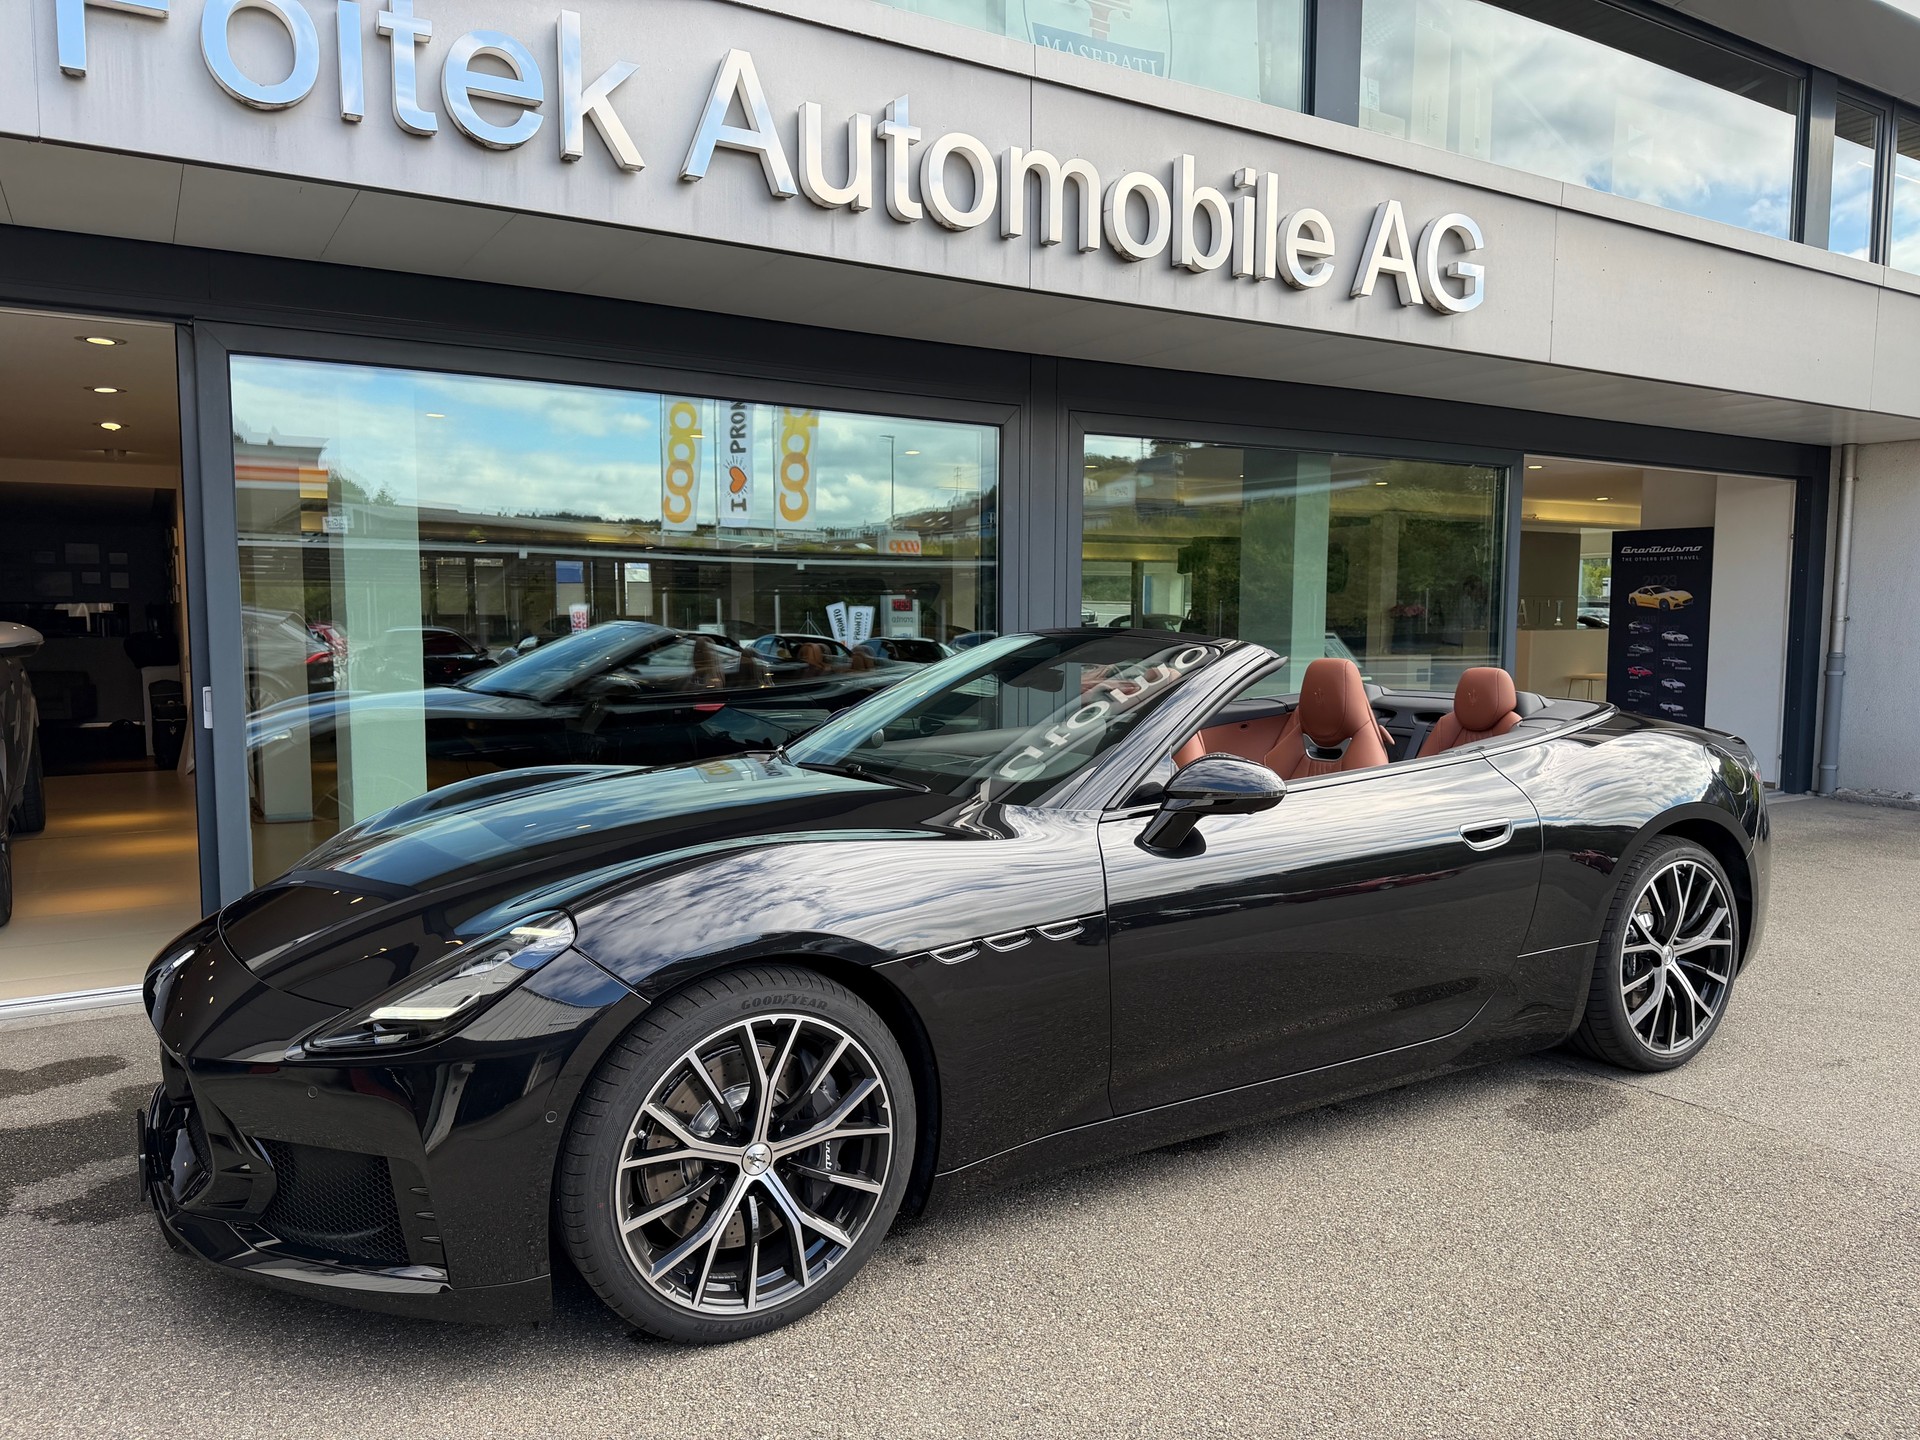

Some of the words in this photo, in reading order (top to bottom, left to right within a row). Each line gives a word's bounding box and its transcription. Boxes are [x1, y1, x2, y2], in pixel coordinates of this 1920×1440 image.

[679, 48, 1336, 291] Automobile
[1350, 200, 1485, 315] AG
[1620, 545, 1703, 554] GranTurismo
[833, 608, 846, 637] PRONTO
[852, 611, 863, 641] PRONTO
[741, 993, 828, 1010] GOODYEAR
